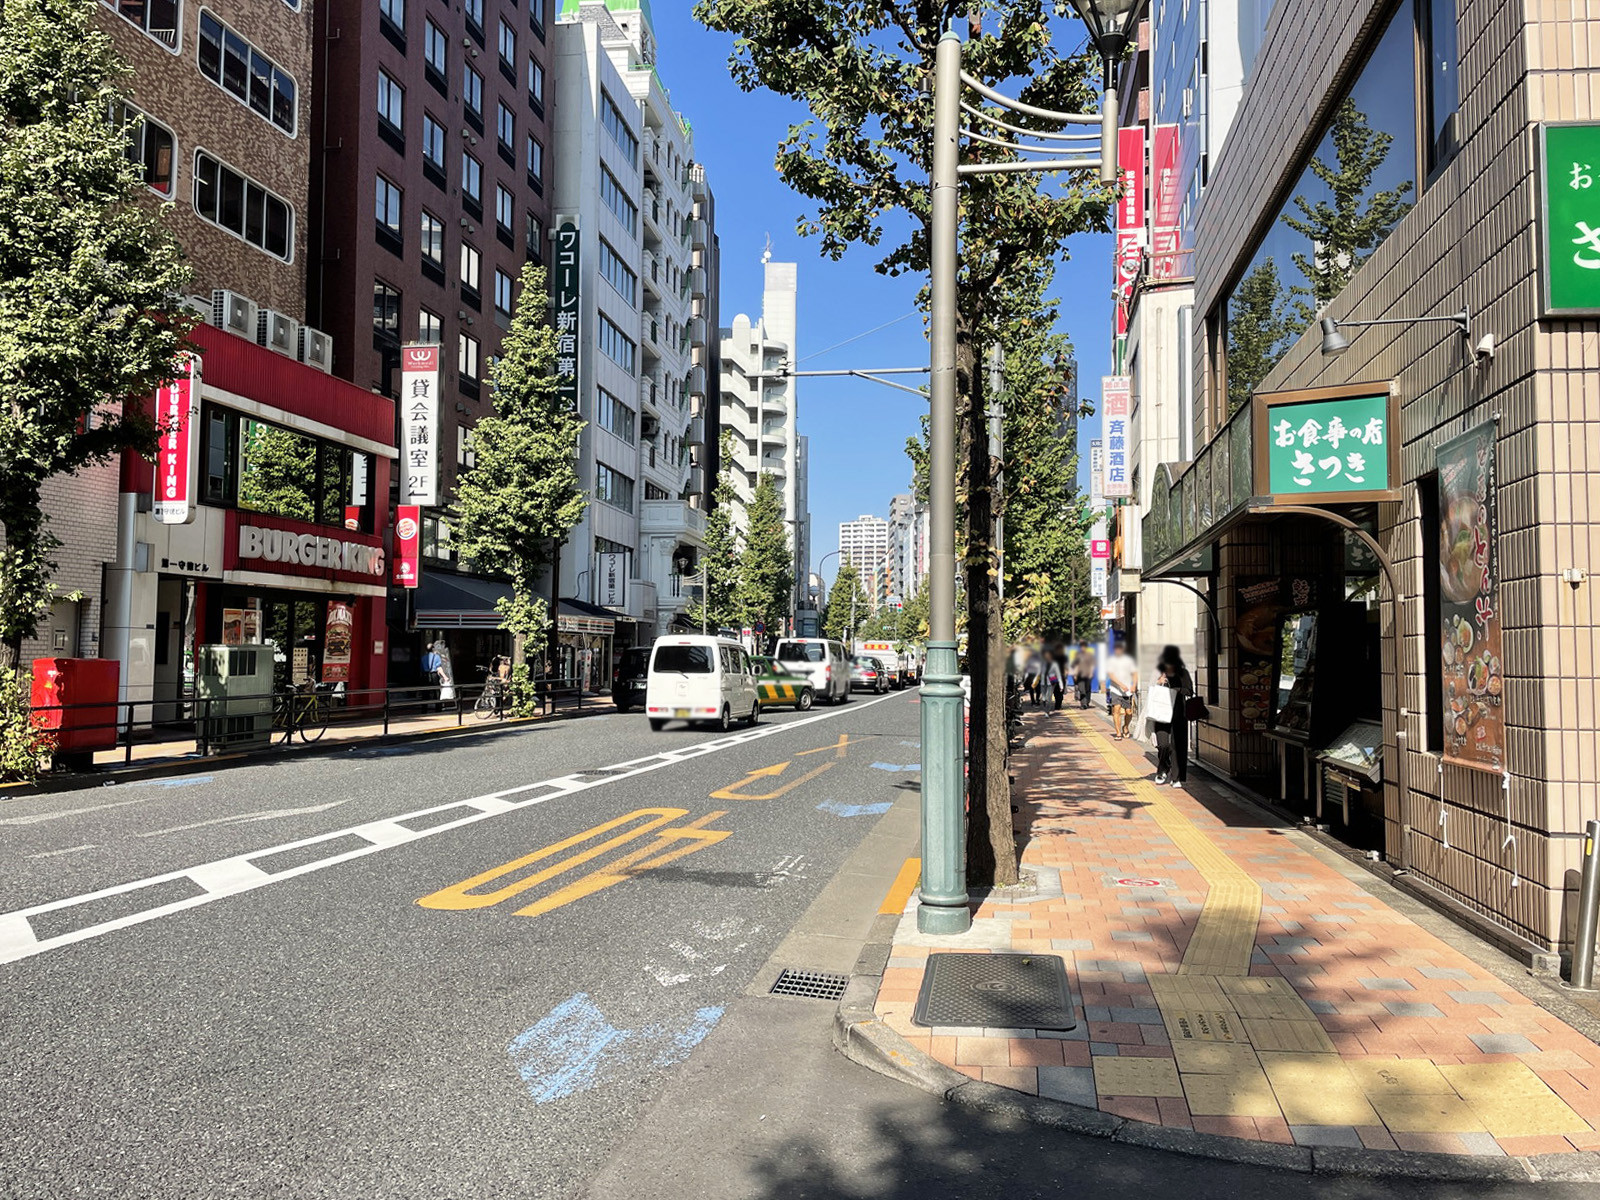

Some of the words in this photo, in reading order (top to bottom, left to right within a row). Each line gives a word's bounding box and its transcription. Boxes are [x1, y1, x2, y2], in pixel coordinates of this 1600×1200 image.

[1569, 161, 1600, 190] お
[1105, 393, 1128, 416] 酒
[410, 379, 429, 468] 貸会議室
[1273, 416, 1383, 449] お食事の店
[166, 453, 177, 499] KING
[409, 476, 428, 488] 2F
[1291, 450, 1366, 486] さつき
[239, 525, 342, 570] BURGER
[342, 541, 385, 576] KING
